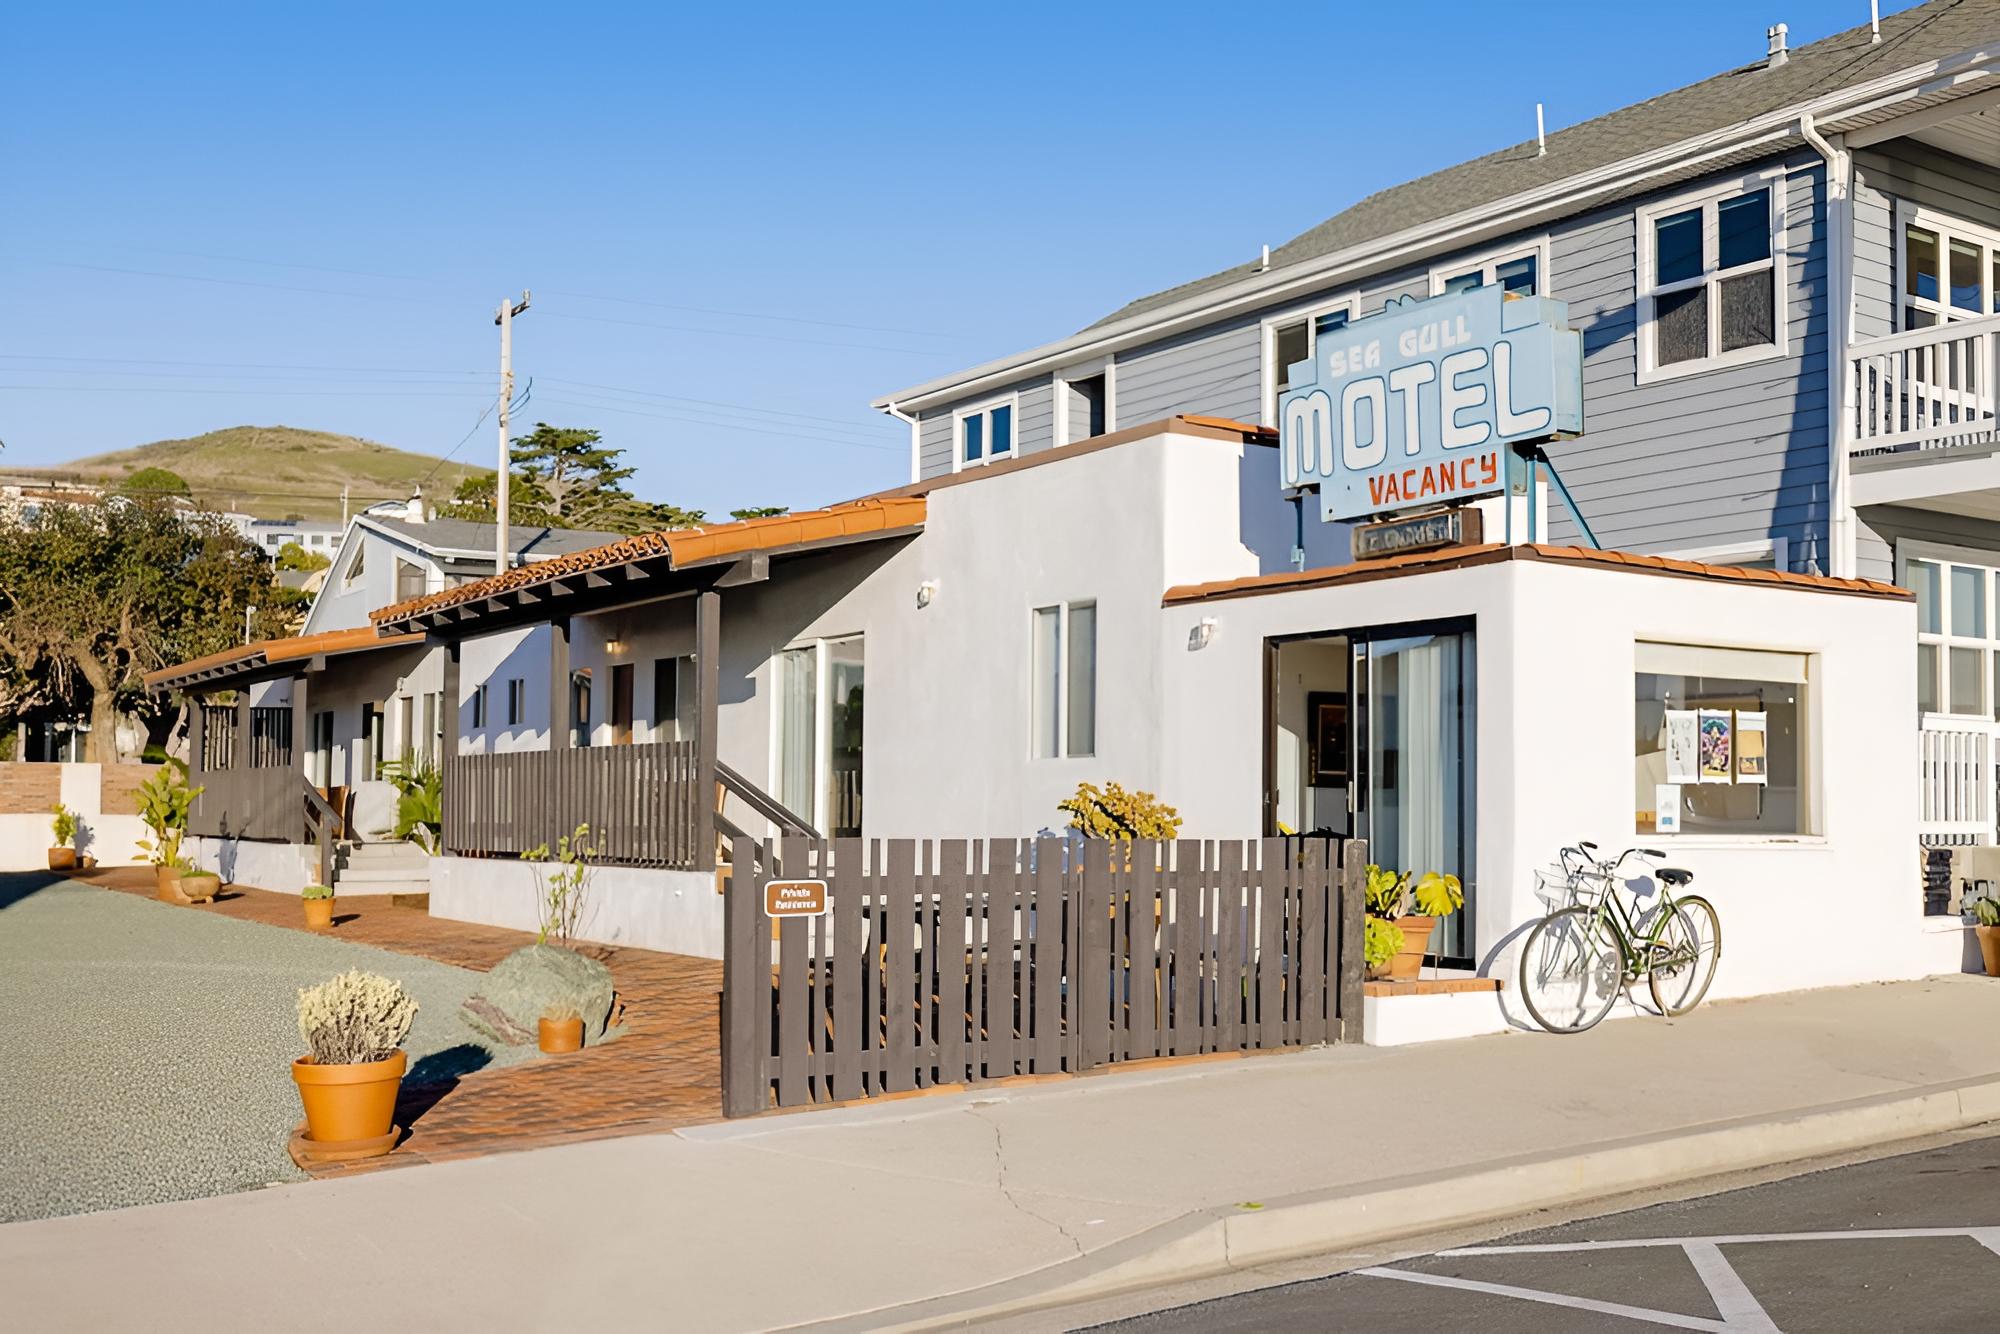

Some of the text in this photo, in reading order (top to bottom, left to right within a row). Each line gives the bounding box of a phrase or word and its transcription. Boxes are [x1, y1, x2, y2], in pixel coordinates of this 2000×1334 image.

[1329, 314, 1473, 379] SEA GULL
[1285, 340, 1551, 485] MOTEL
[1368, 451, 1497, 505] VACANCY
